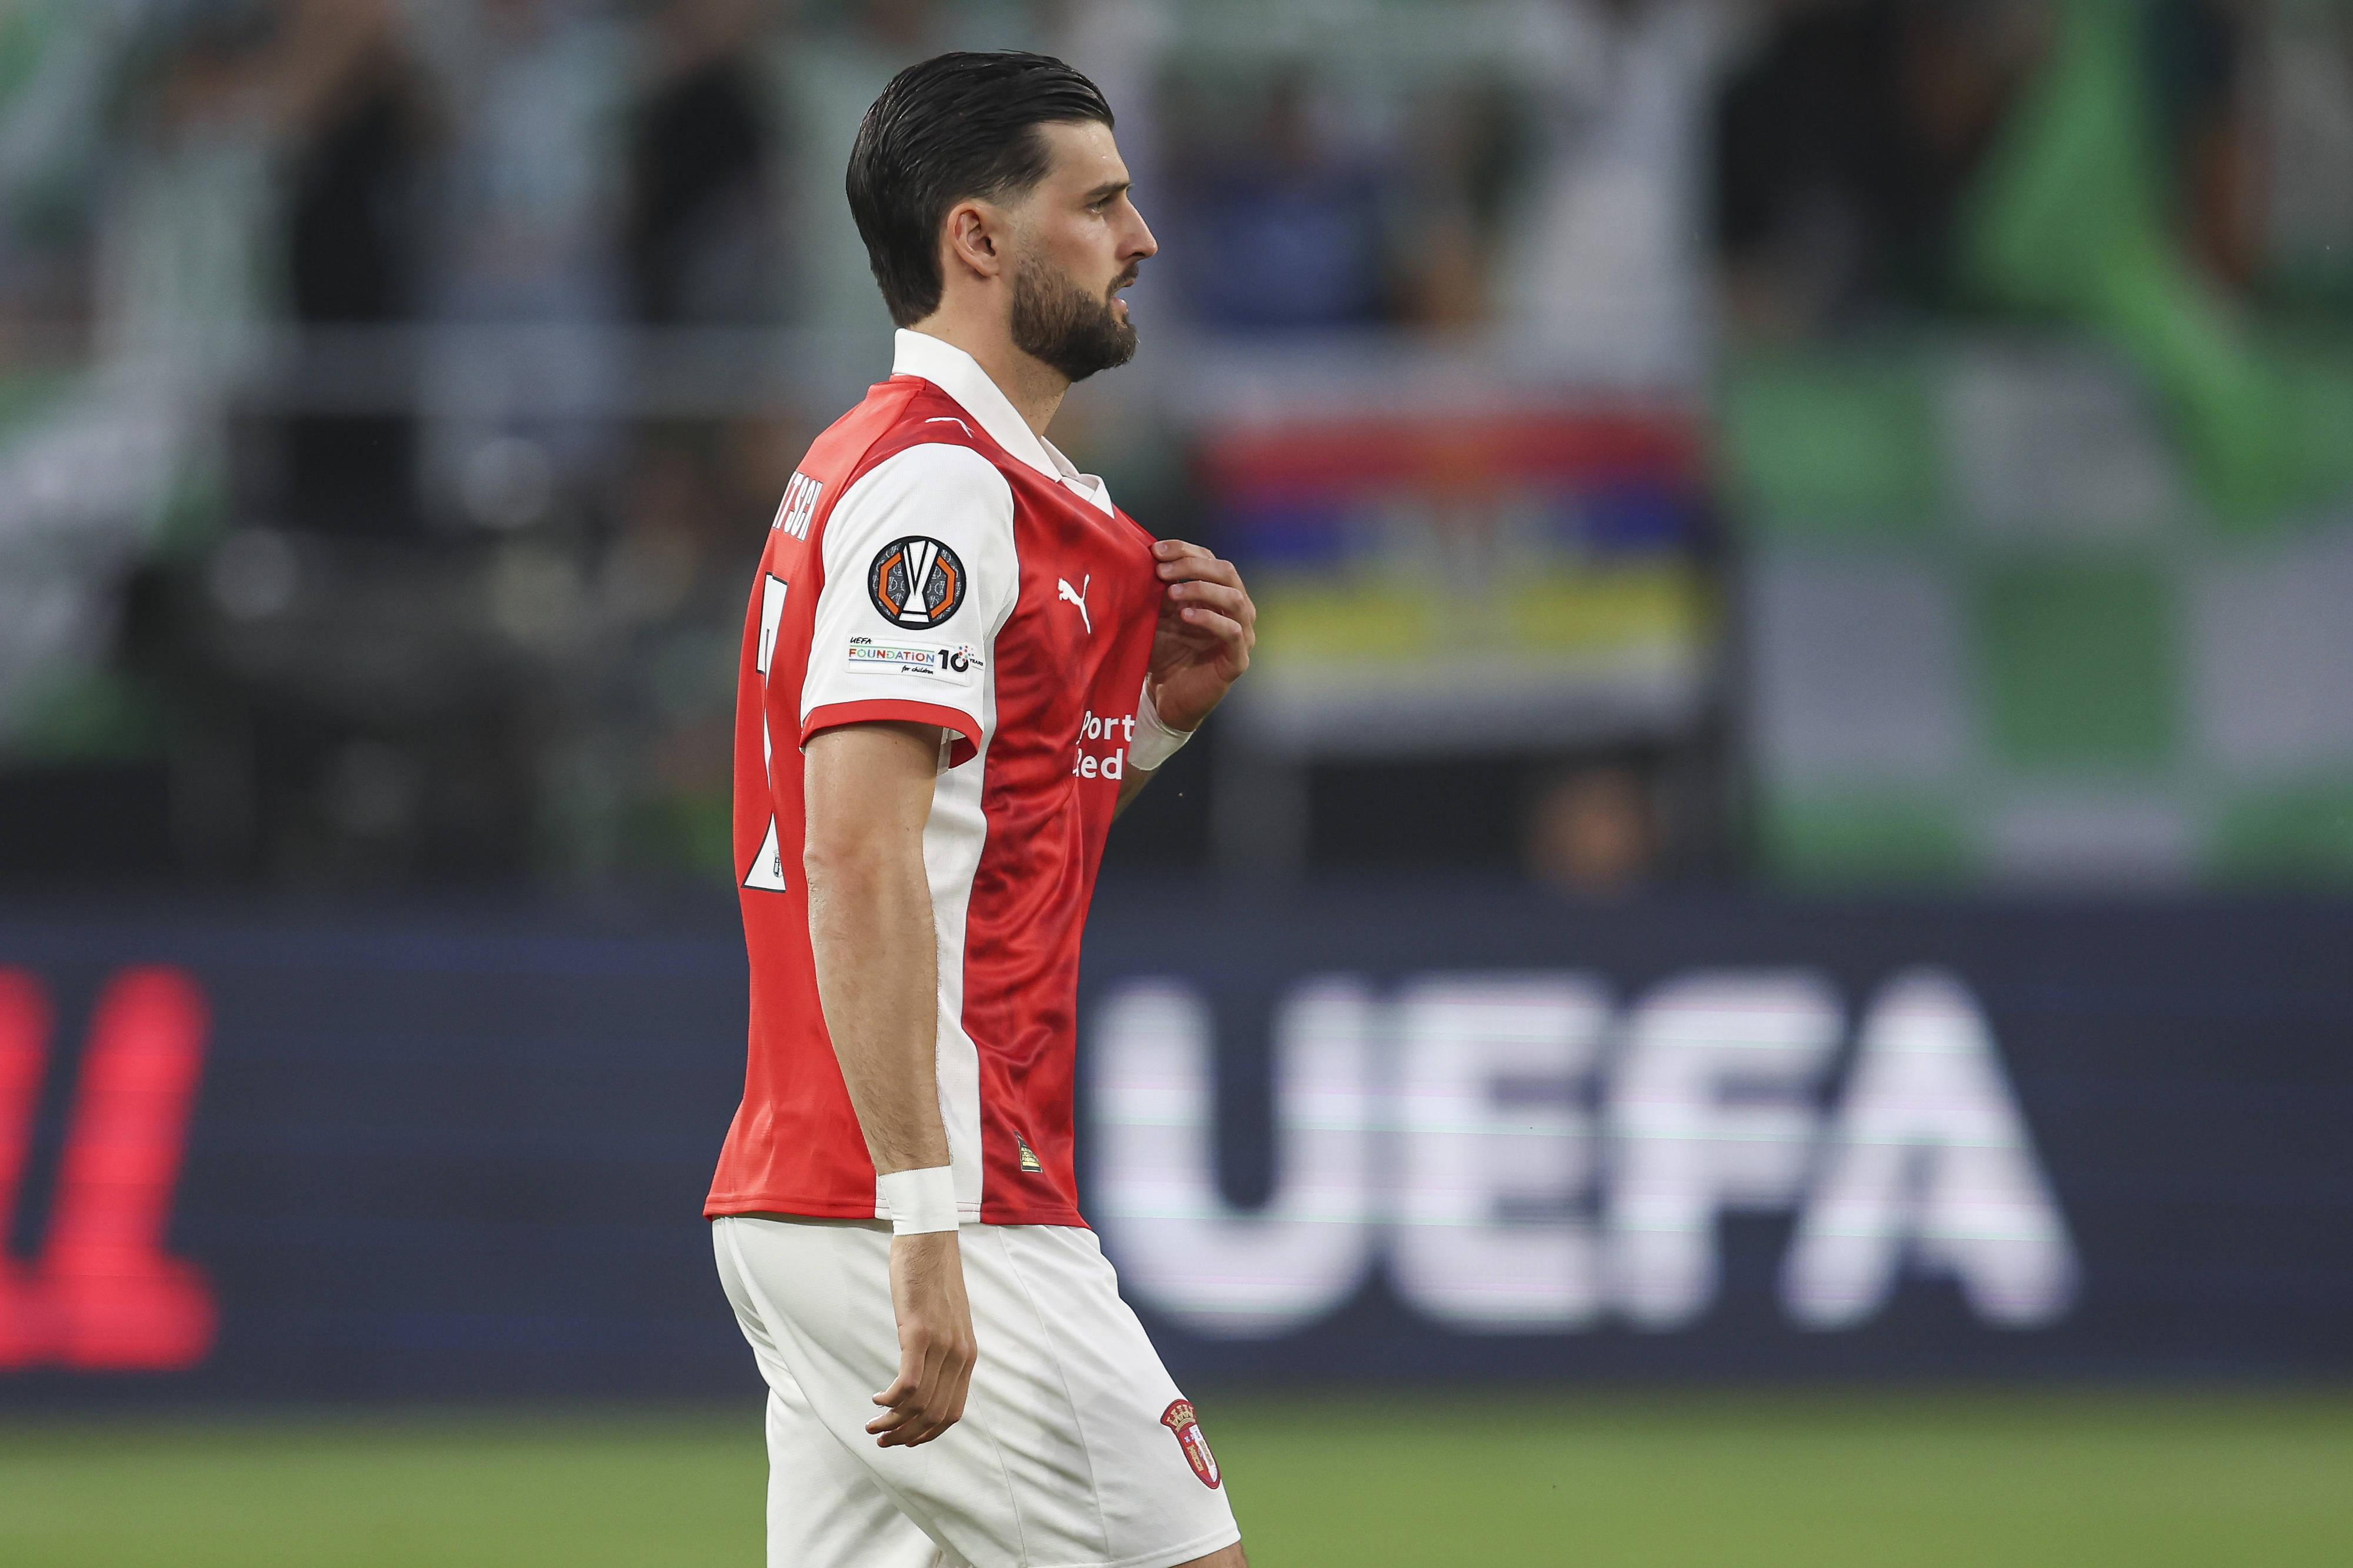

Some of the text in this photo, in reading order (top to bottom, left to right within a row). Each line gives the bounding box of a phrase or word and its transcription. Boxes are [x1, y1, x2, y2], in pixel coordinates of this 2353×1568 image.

[911, 666, 934, 675] children
[938, 649, 969, 672] 10
[1095, 972, 2077, 1334] UEFA
